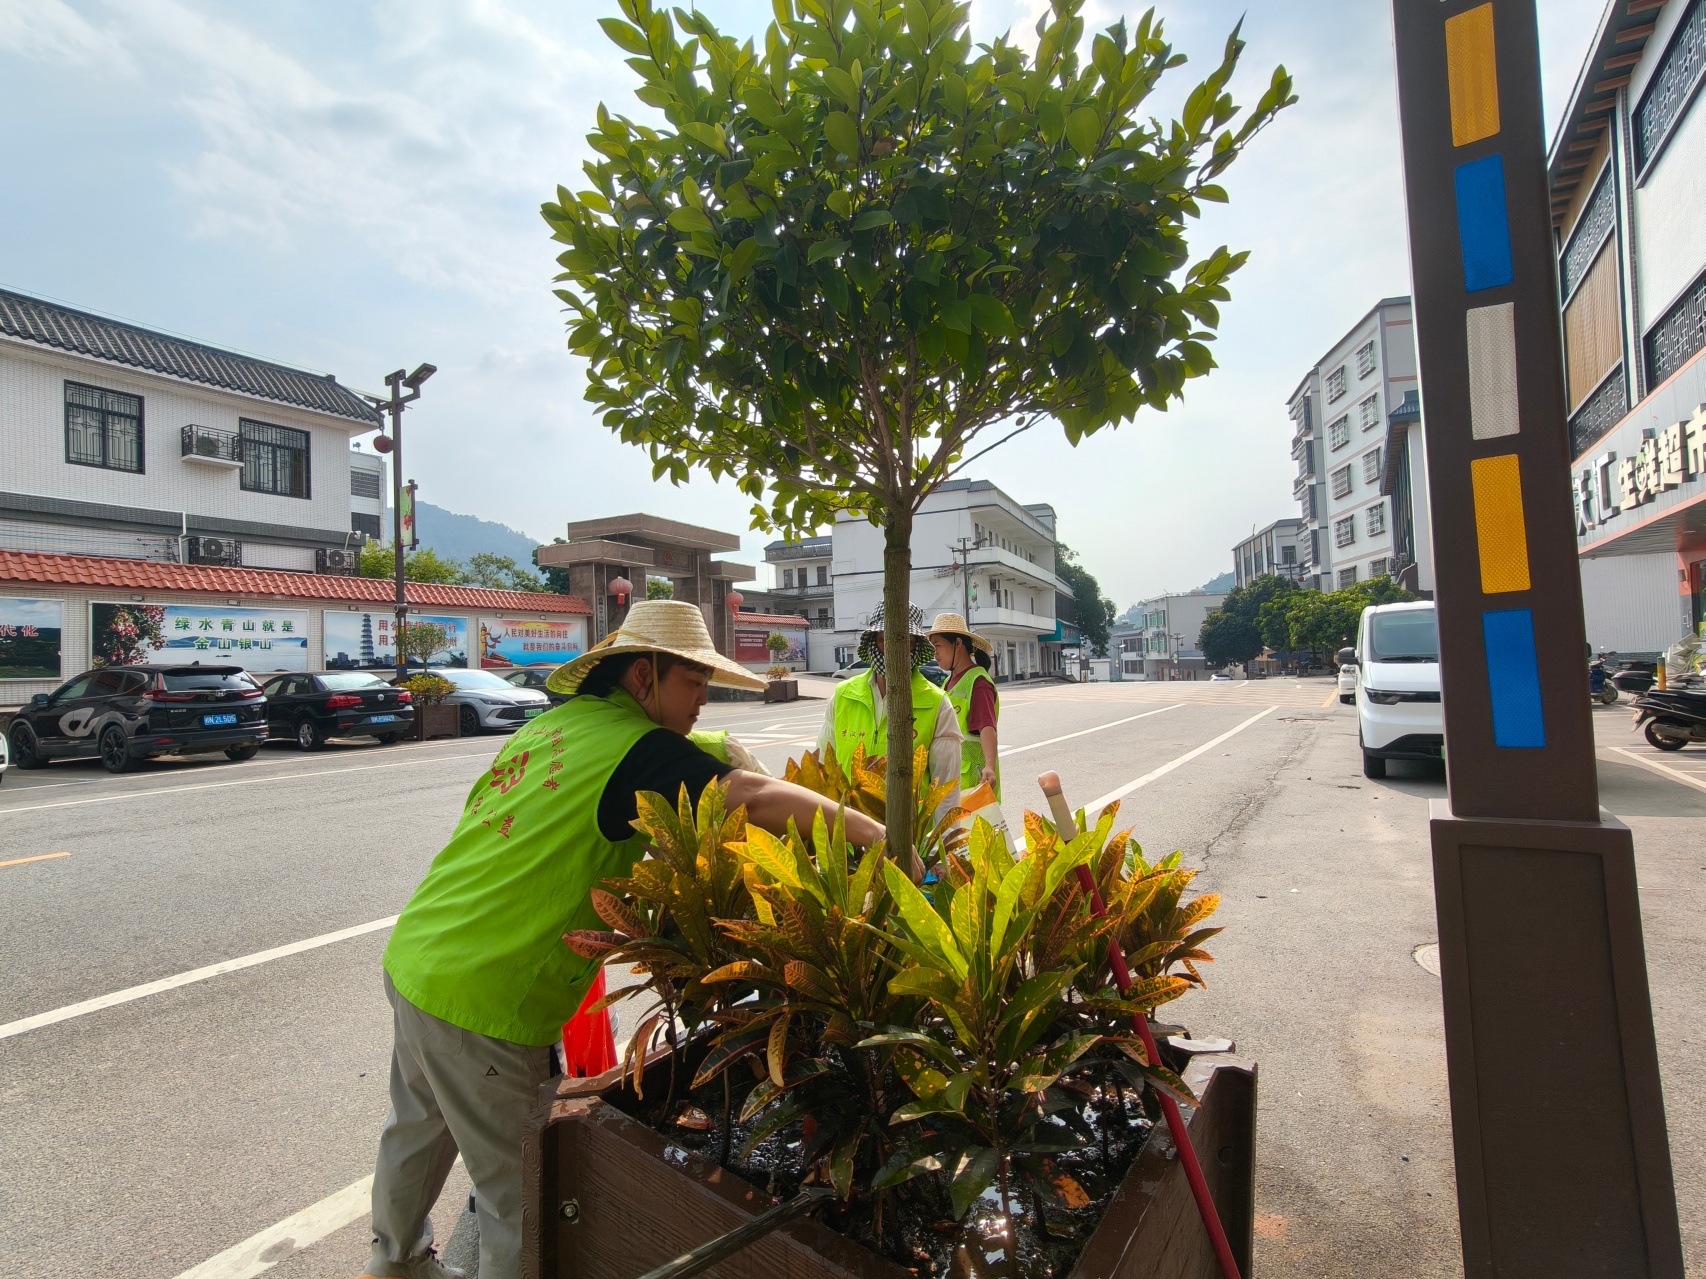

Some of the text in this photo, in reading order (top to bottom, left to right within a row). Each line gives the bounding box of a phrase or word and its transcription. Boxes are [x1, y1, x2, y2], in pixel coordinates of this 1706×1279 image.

[174, 616, 295, 633] 绿水青山就是
[503, 627, 568, 639] 人民对美好生活的向往
[194, 637, 273, 651] 金山银山
[522, 642, 579, 652] 就是我们的奋斗目标
